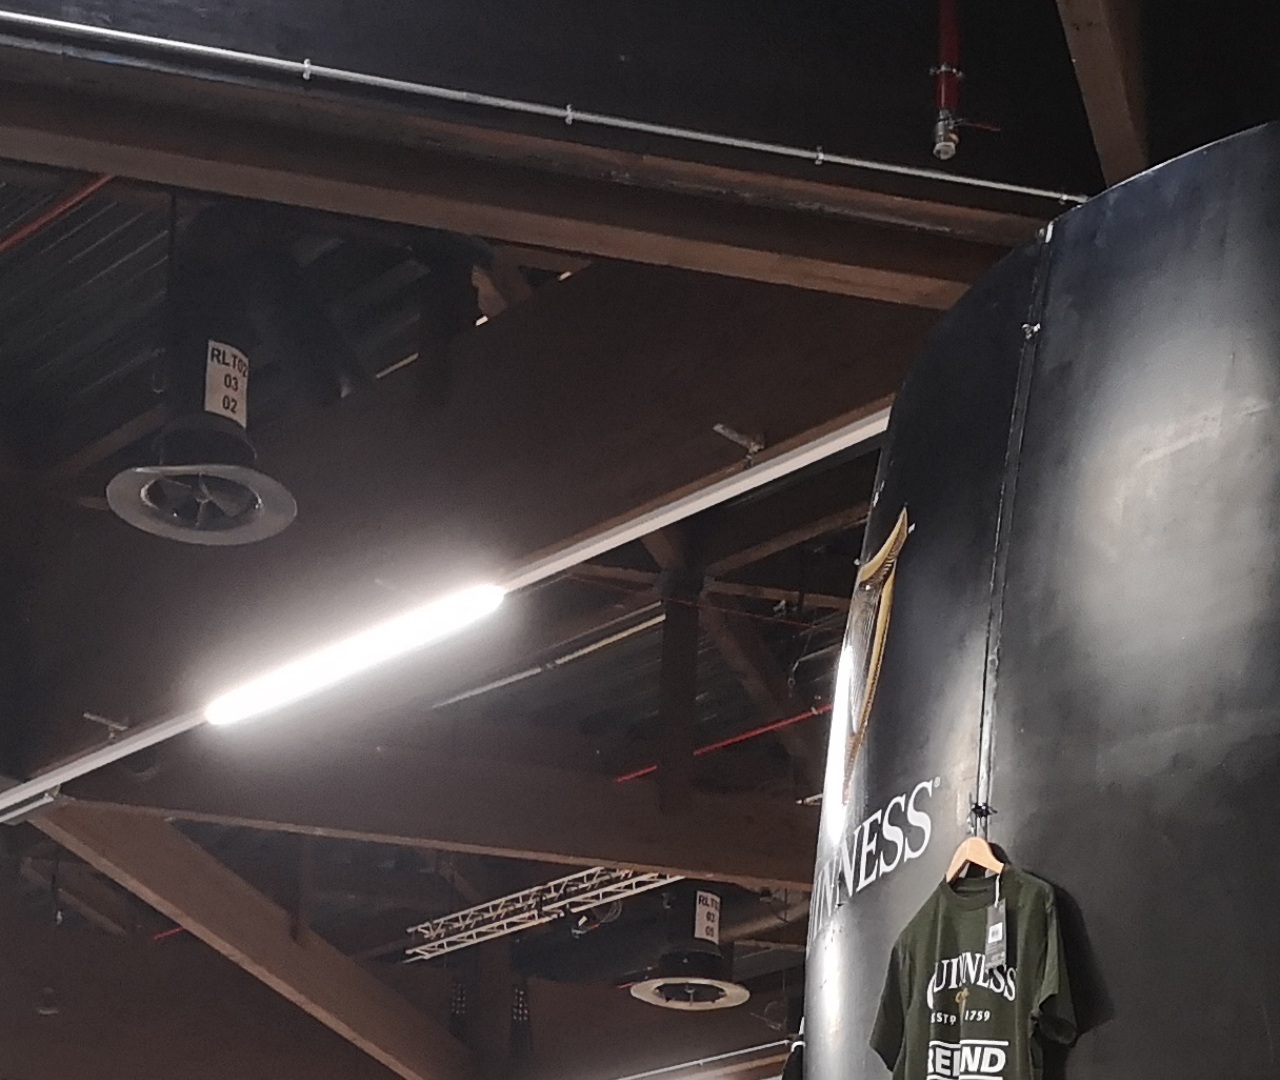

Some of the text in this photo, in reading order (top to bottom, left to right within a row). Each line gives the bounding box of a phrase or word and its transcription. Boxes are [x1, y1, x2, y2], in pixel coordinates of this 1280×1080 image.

[210, 347, 249, 378] RLT02
[224, 373, 239, 392] 03
[222, 394, 238, 414] 02
[964, 1010, 991, 1023] 1759
